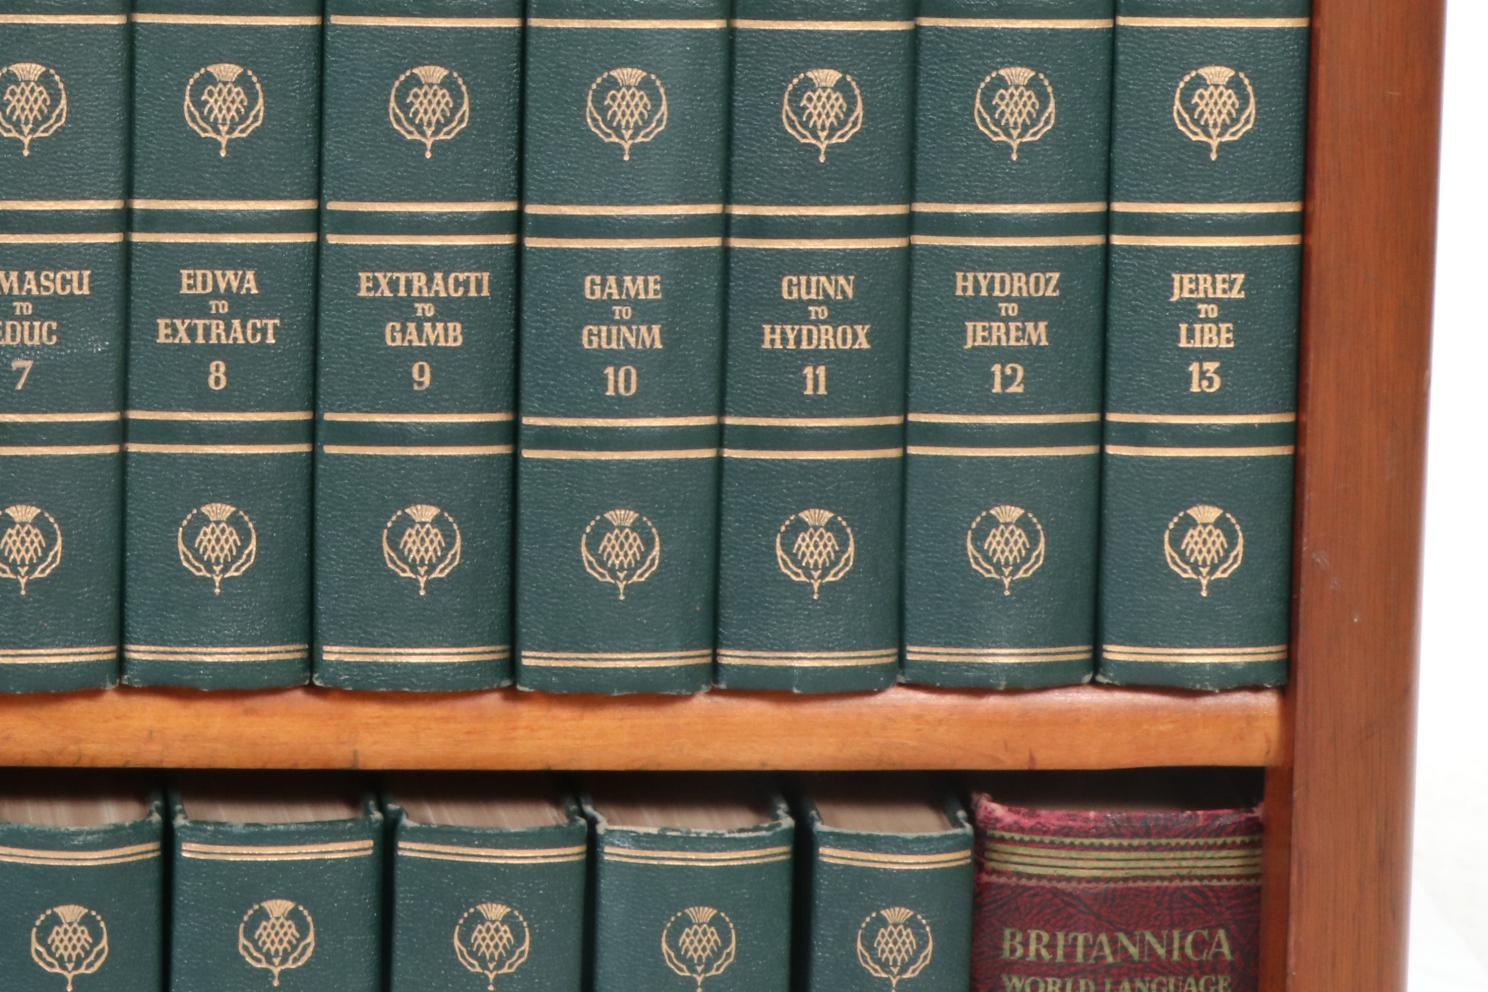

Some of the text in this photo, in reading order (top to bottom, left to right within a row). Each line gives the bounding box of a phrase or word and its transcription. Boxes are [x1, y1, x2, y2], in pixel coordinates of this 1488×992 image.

[179, 268, 260, 295] EDWA
[357, 271, 491, 298] EXTRACTI
[583, 274, 662, 301] GAME
[780, 274, 856, 301] GUNN
[954, 271, 1061, 298] HYDROZ
[1169, 271, 1246, 303] JEREZ
[13, 300, 34, 316] TO
[208, 299, 230, 314] TO
[415, 301, 436, 318] TO
[613, 305, 633, 321] TO
[809, 304, 829, 321] TO
[998, 301, 1019, 317] TO
[1196, 302, 1220, 319] TO
[156, 317, 281, 345] EXTRACT
[384, 320, 464, 348] GAMB
[581, 323, 663, 350] GUNM
[762, 323, 871, 350] HYDROX
[963, 320, 1050, 350] JEREM
[1177, 321, 1236, 349] LIBE
[11, 358, 34, 390] 7
[207, 359, 228, 391] 8
[411, 360, 432, 390] 9
[603, 364, 639, 397] 10
[803, 364, 828, 396] 11
[991, 362, 1025, 394] 12
[1188, 360, 1222, 393] 13
[1000, 927, 1234, 964] BRITANNICA
[1000, 973, 1232, 992] WORLD LANGUAGE
